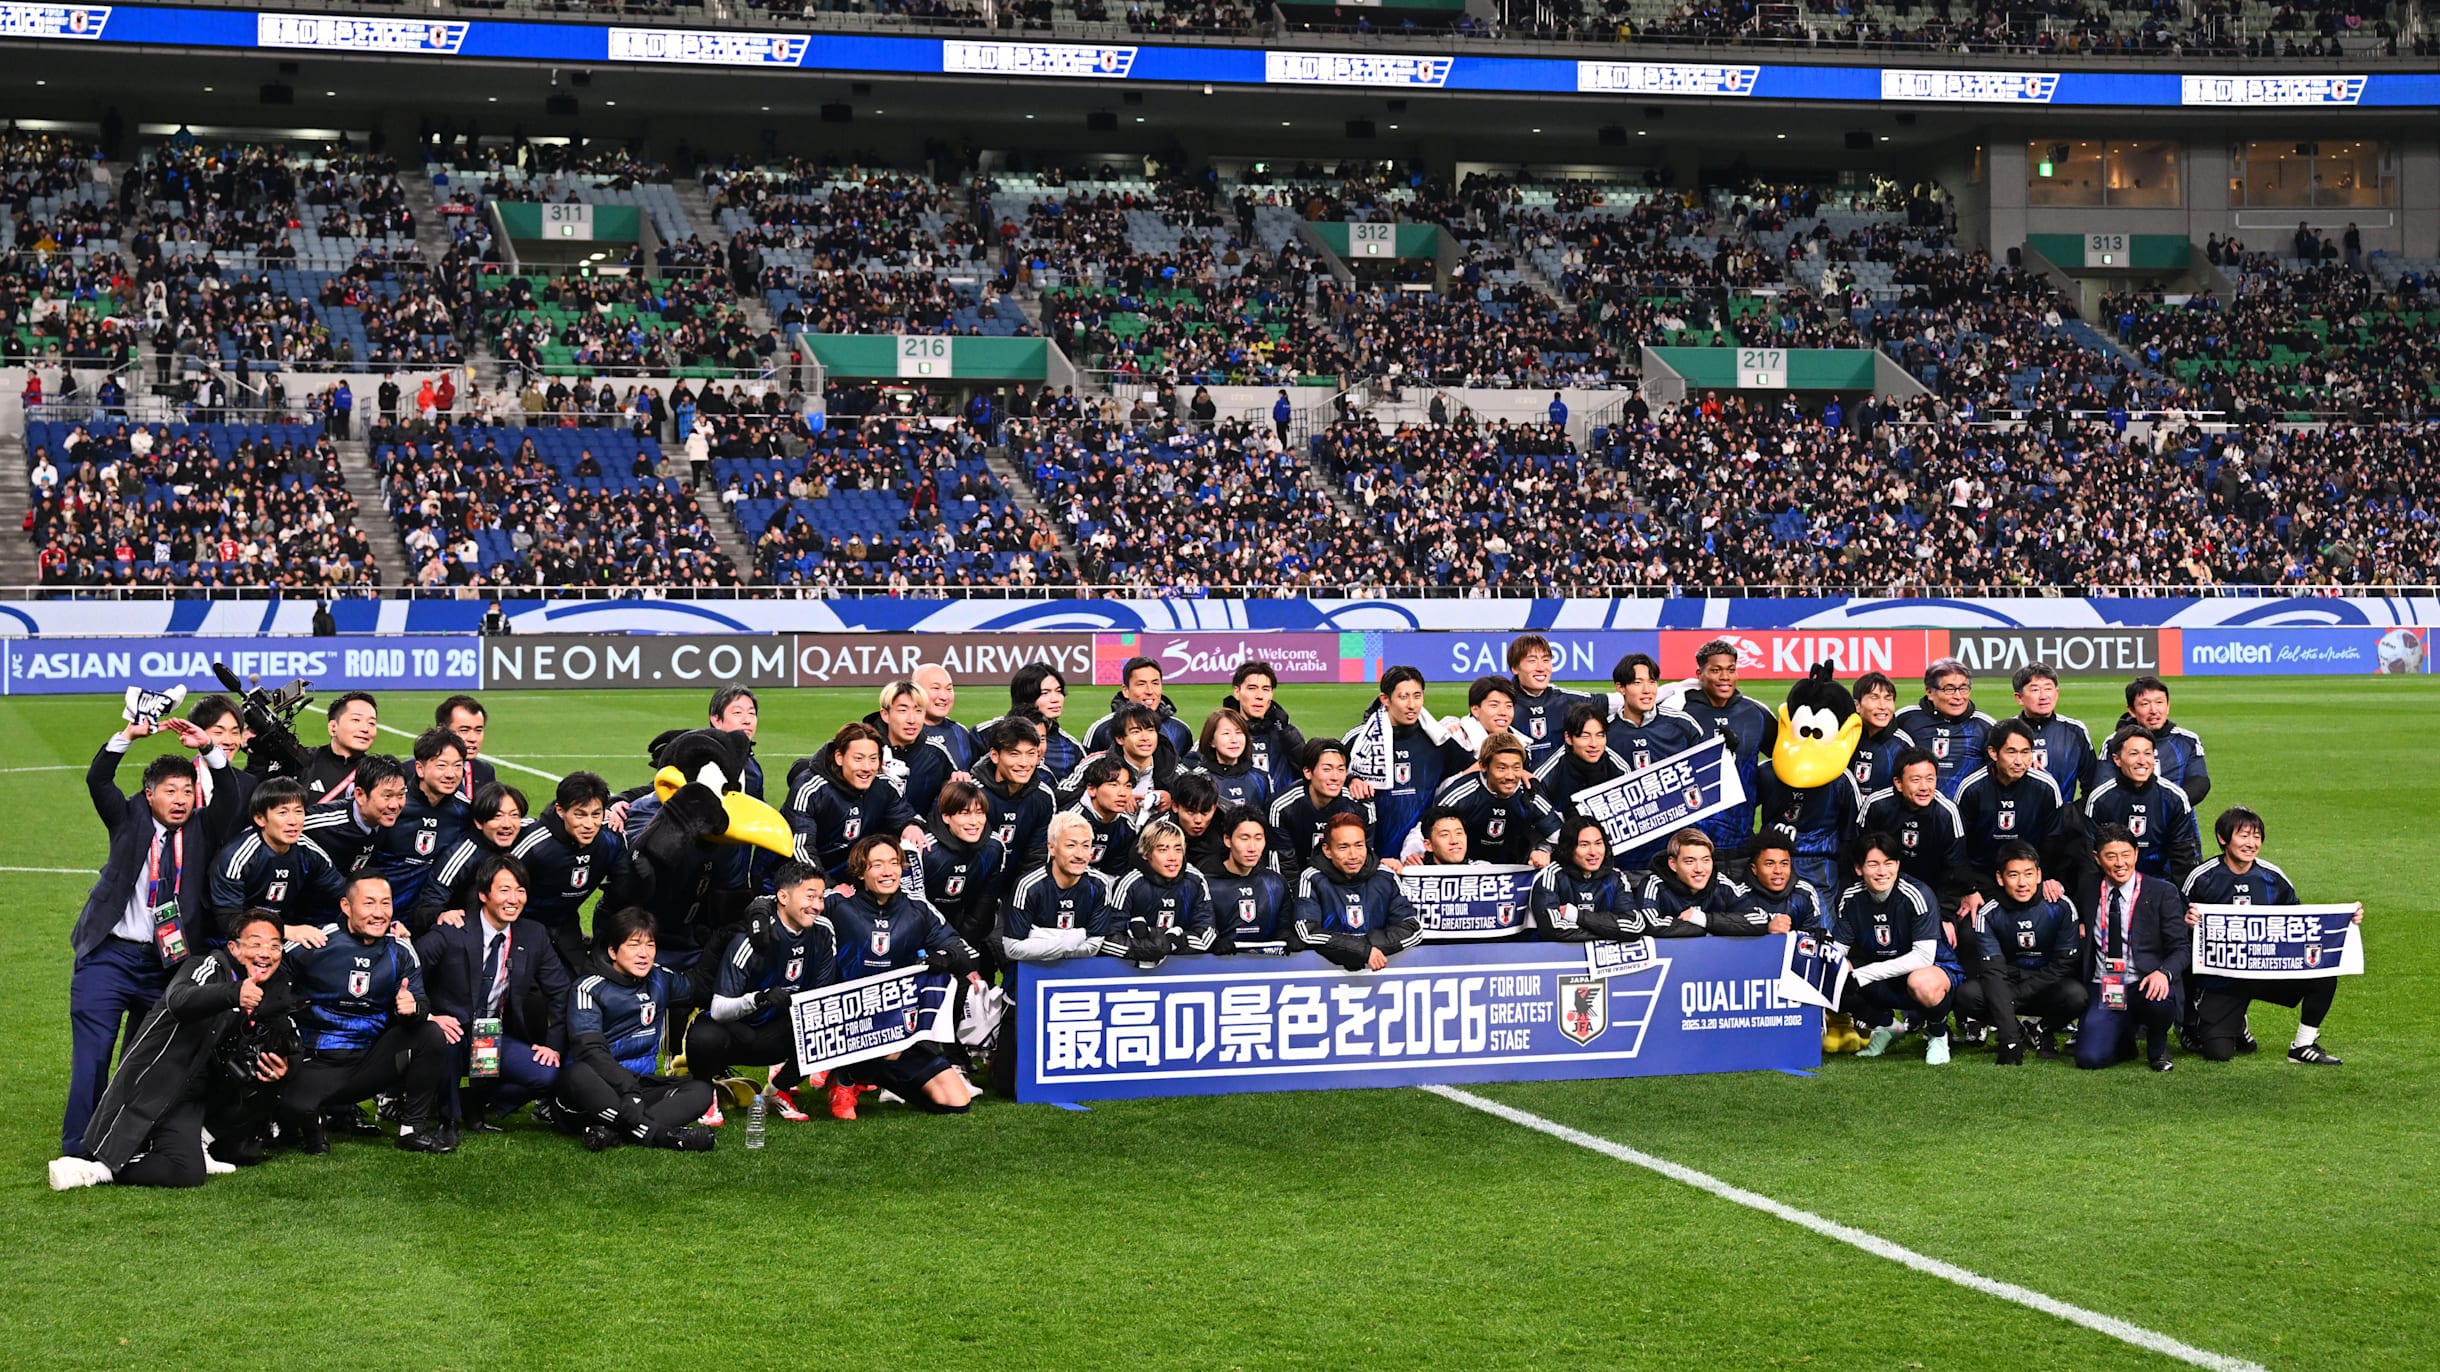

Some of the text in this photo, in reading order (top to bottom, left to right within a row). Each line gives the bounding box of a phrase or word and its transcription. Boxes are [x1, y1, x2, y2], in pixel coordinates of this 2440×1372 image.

[551, 205, 582, 220] 311
[1358, 225, 1388, 240] 312
[2093, 236, 2122, 249] 313
[905, 338, 945, 357] 216
[1744, 351, 1780, 368] 217
[27, 652, 131, 679] ASIAN
[345, 648, 406, 678] ROAD
[412, 649, 439, 677] TO
[446, 648, 477, 677] 26
[492, 644, 785, 681] NEOM.COM
[799, 645, 1089, 679] QATAR AIRWAYS
[1257, 647, 1318, 660] Welcome
[1285, 659, 1328, 672] Arabia
[1451, 640, 1594, 674] SAION
[1772, 637, 1893, 673] KIRIN
[1955, 636, 2156, 671] APA HOTEL
[2192, 641, 2272, 665] molten
[12, 653, 23, 679] AFC
[1586, 760, 1695, 821] 最高の景色を
[1402, 874, 1515, 902] 最高の景色を
[1441, 903, 1455, 916] FOR
[1454, 903, 1469, 916] OUR
[1441, 916, 1497, 930] GREATEST STAGE
[2206, 915, 2322, 943] 最高の景色を
[2206, 942, 2276, 970] 2026 FOR OUR
[2248, 957, 2304, 970] GREATEST STAGE
[1489, 975, 1541, 998] FOR OUR
[1681, 979, 1802, 1017] QUALIFIE
[802, 976, 919, 1031] 最高の景色を
[1489, 1001, 1554, 1024] GREATEST
[1046, 976, 1487, 1071] 最高の景色を2026
[1572, 1022, 1594, 1032] JFA
[1681, 1014, 1802, 1031] 2025.3.20 SAITAMA STADIUM 2002
[805, 1017, 874, 1061] 2026 FOR OUR
[847, 1025, 905, 1051] GREATEST STAGE
[1489, 1030, 1531, 1051] STAGE
